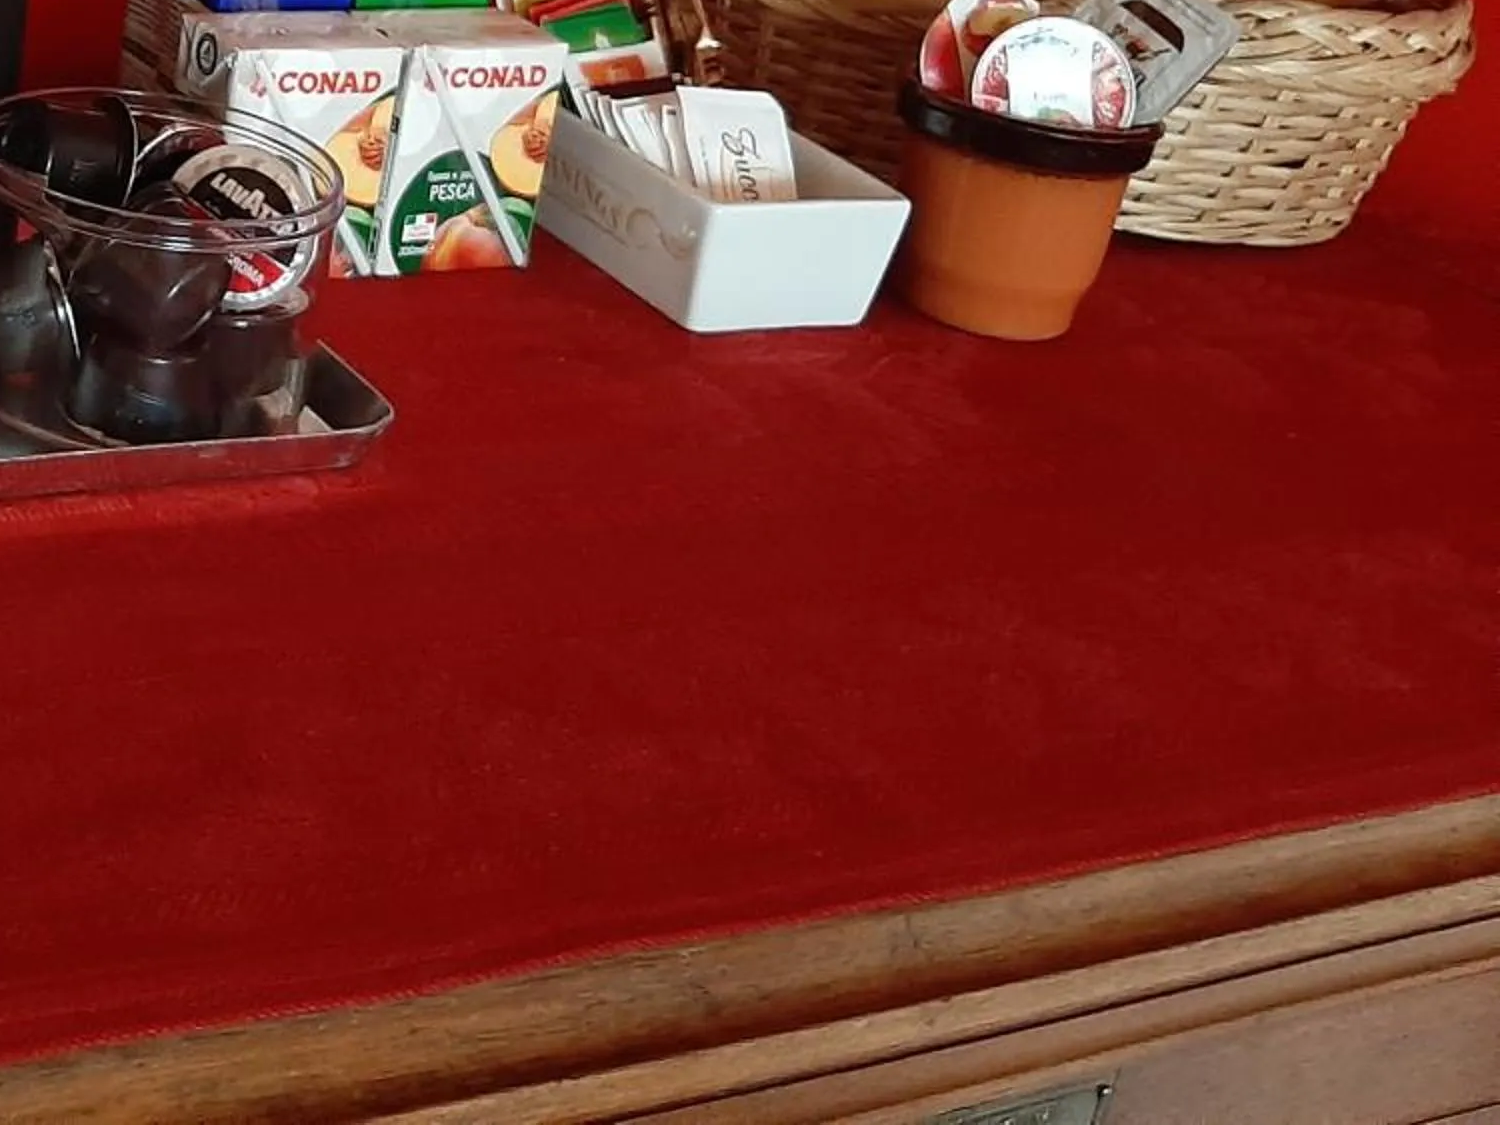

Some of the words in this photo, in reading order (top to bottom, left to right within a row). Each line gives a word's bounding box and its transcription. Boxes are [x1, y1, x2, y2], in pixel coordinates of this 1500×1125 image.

[278, 71, 382, 95] CONAD
[450, 65, 547, 90] CONAD
[429, 182, 476, 203] PESCA
